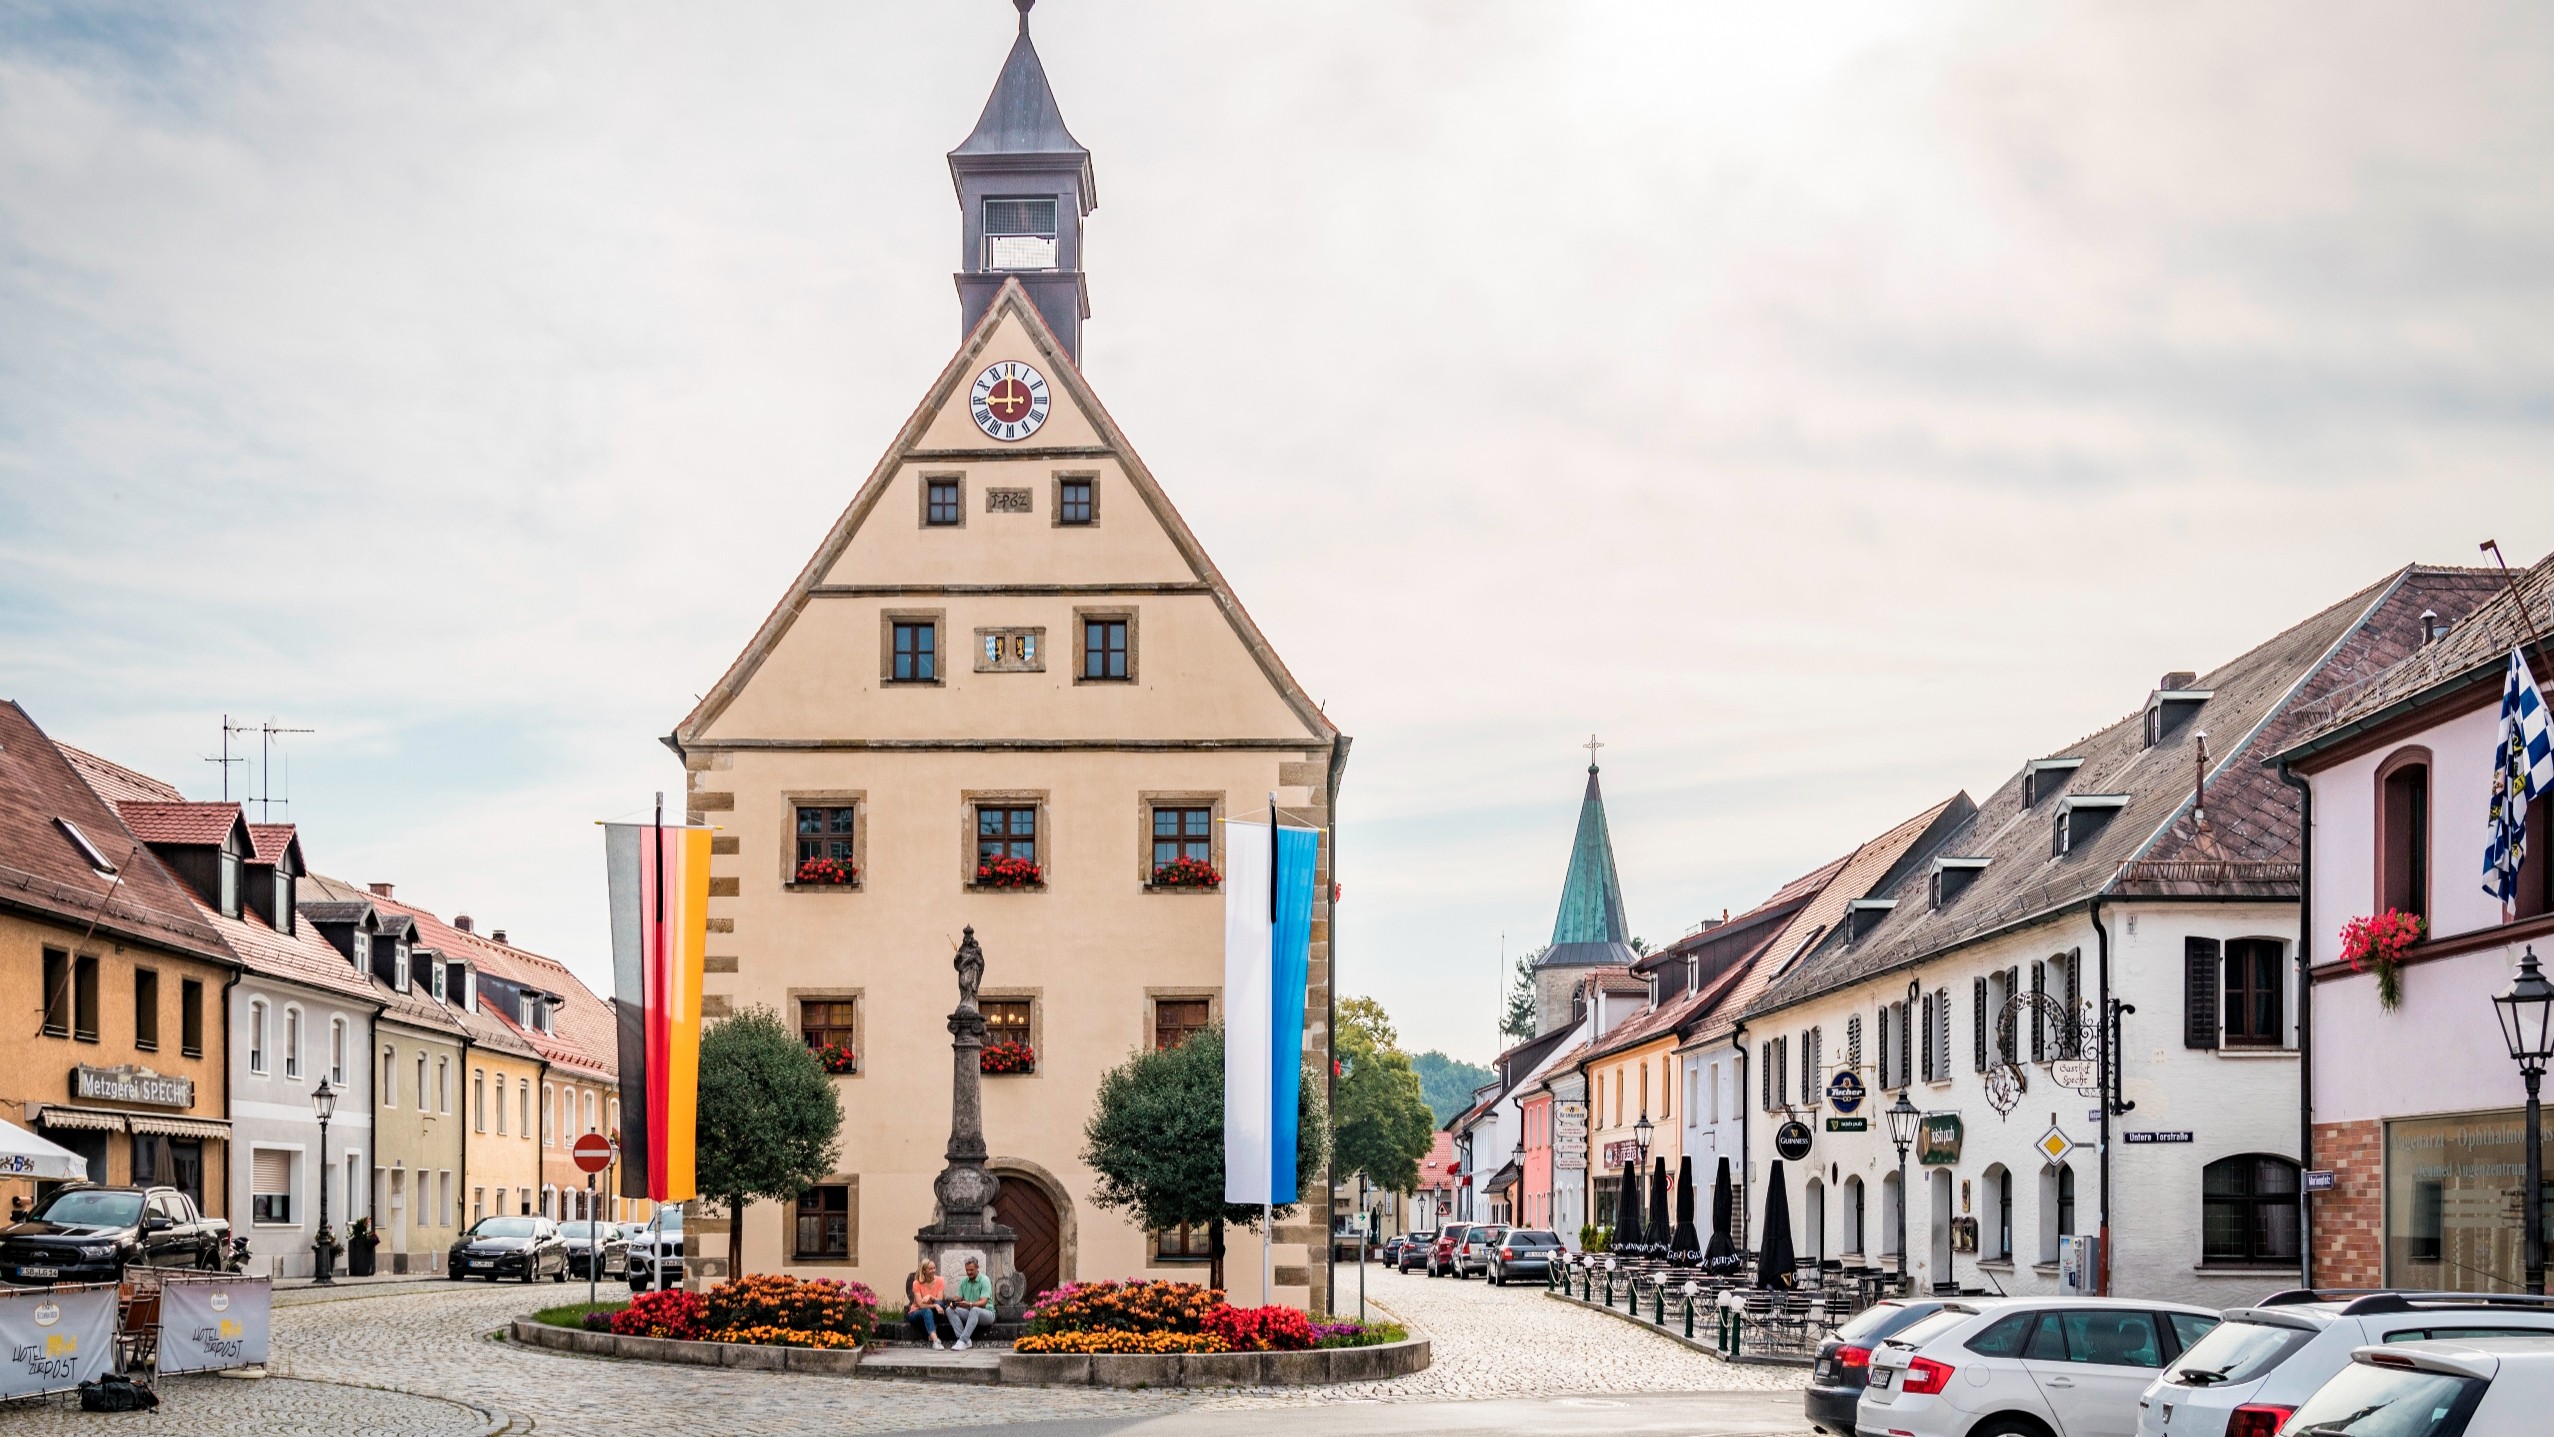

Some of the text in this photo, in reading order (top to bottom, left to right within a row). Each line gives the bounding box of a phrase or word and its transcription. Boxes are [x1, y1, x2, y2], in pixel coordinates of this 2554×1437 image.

[2060, 1062, 2091, 1074] Gasthof
[84, 1073, 188, 1103] Metzgerei SPECHT
[1831, 1088, 1862, 1096] Tucher
[1944, 1125, 1955, 1145] pub
[2129, 1132, 2189, 1142] Untere Torstraße
[192, 1326, 219, 1344] HOTEL
[12, 1344, 46, 1363] HOTEL
[214, 1340, 243, 1359] POST
[43, 1357, 78, 1380] POST
